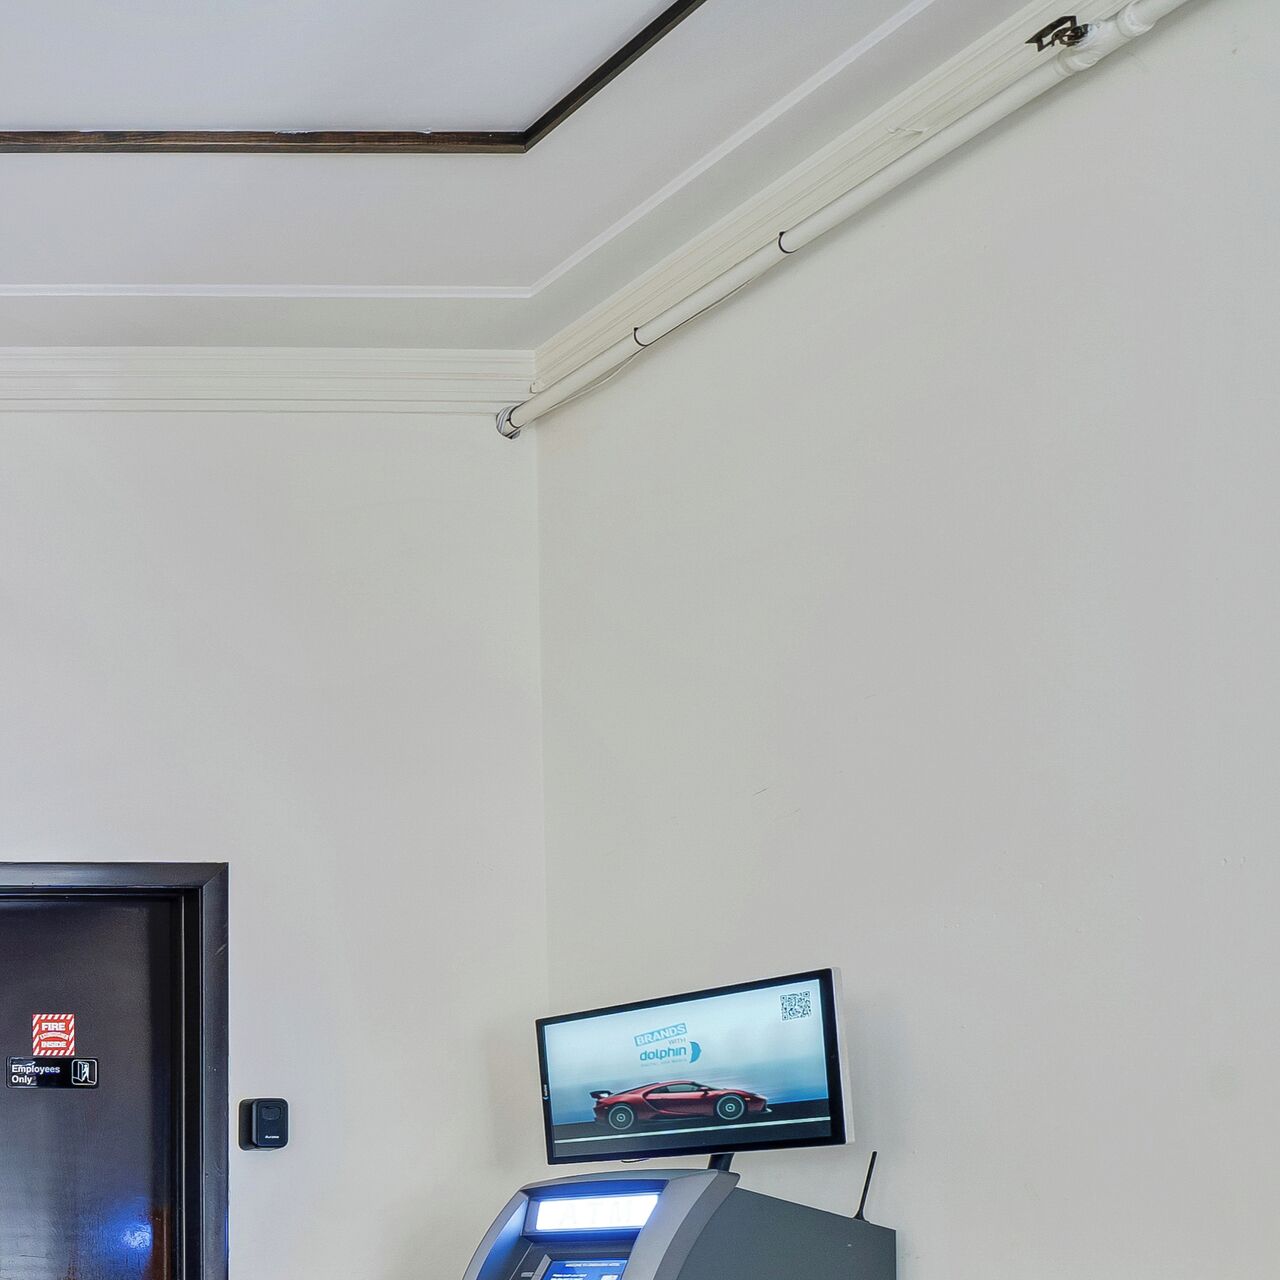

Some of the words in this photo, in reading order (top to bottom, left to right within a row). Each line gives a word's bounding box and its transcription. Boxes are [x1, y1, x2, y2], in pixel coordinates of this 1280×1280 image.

[41, 1022, 66, 1031] FIRE
[636, 1024, 686, 1045] BRANDS
[640, 1046, 687, 1061] dolphin
[11, 1064, 61, 1075] Employees
[11, 1075, 33, 1085] Only
